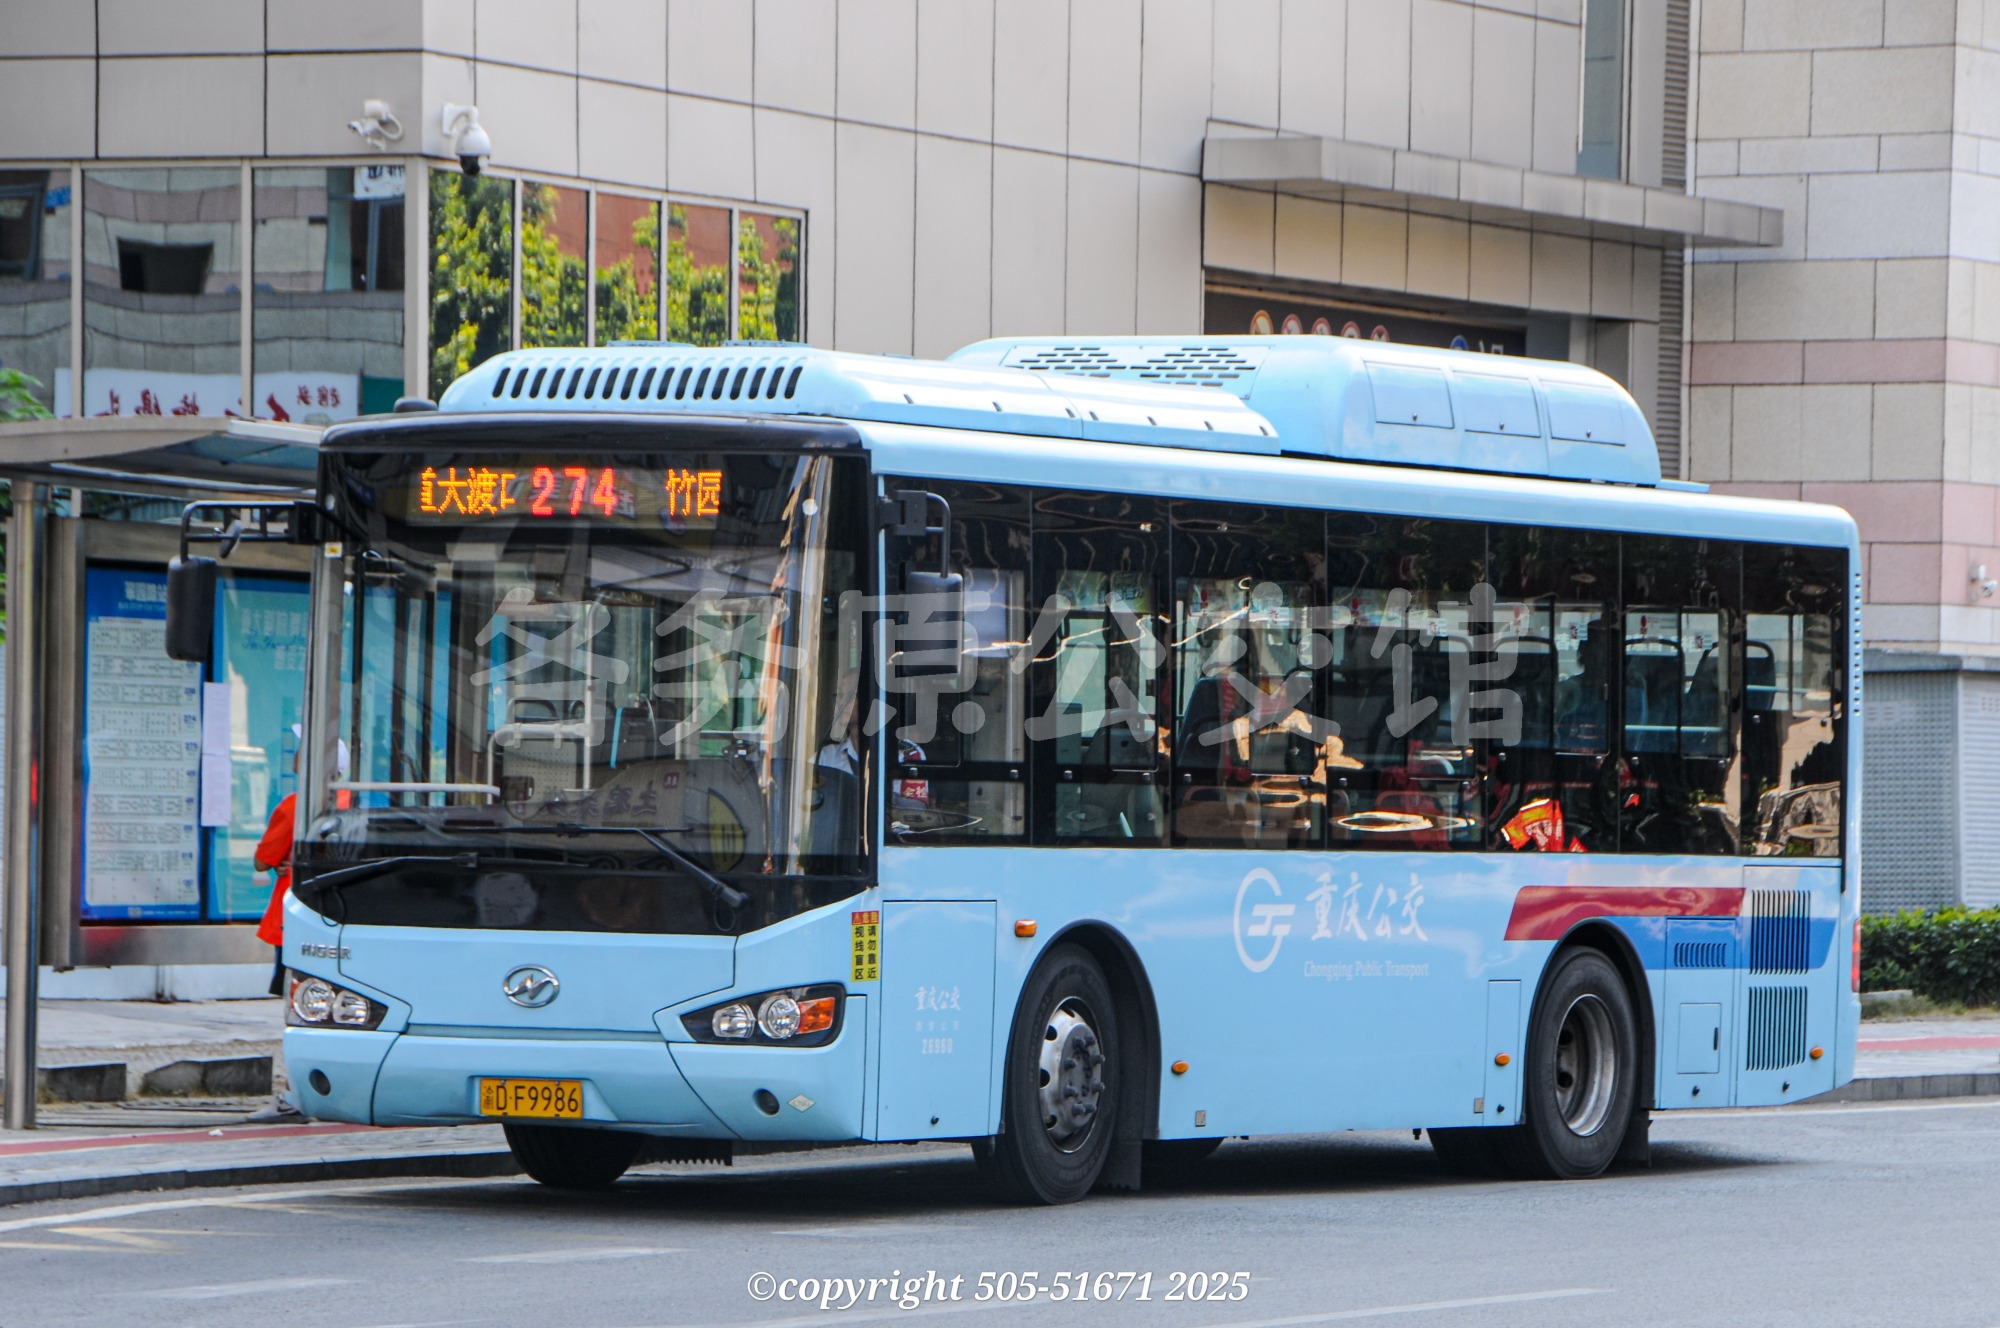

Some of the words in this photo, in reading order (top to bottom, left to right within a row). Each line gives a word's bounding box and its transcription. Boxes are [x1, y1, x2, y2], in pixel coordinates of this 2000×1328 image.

[532, 466, 618, 517] 274
[1305, 871, 1429, 942] 重庆公交
[301, 942, 352, 960] HIGER
[855, 926, 864, 980] 视线盲区
[867, 925, 877, 979] 请勿靠近
[1304, 960, 1353, 981] Chongqing
[1355, 960, 1383, 977] Public
[1386, 960, 1429, 981] Transport
[915, 986, 961, 1010] 重庆公交
